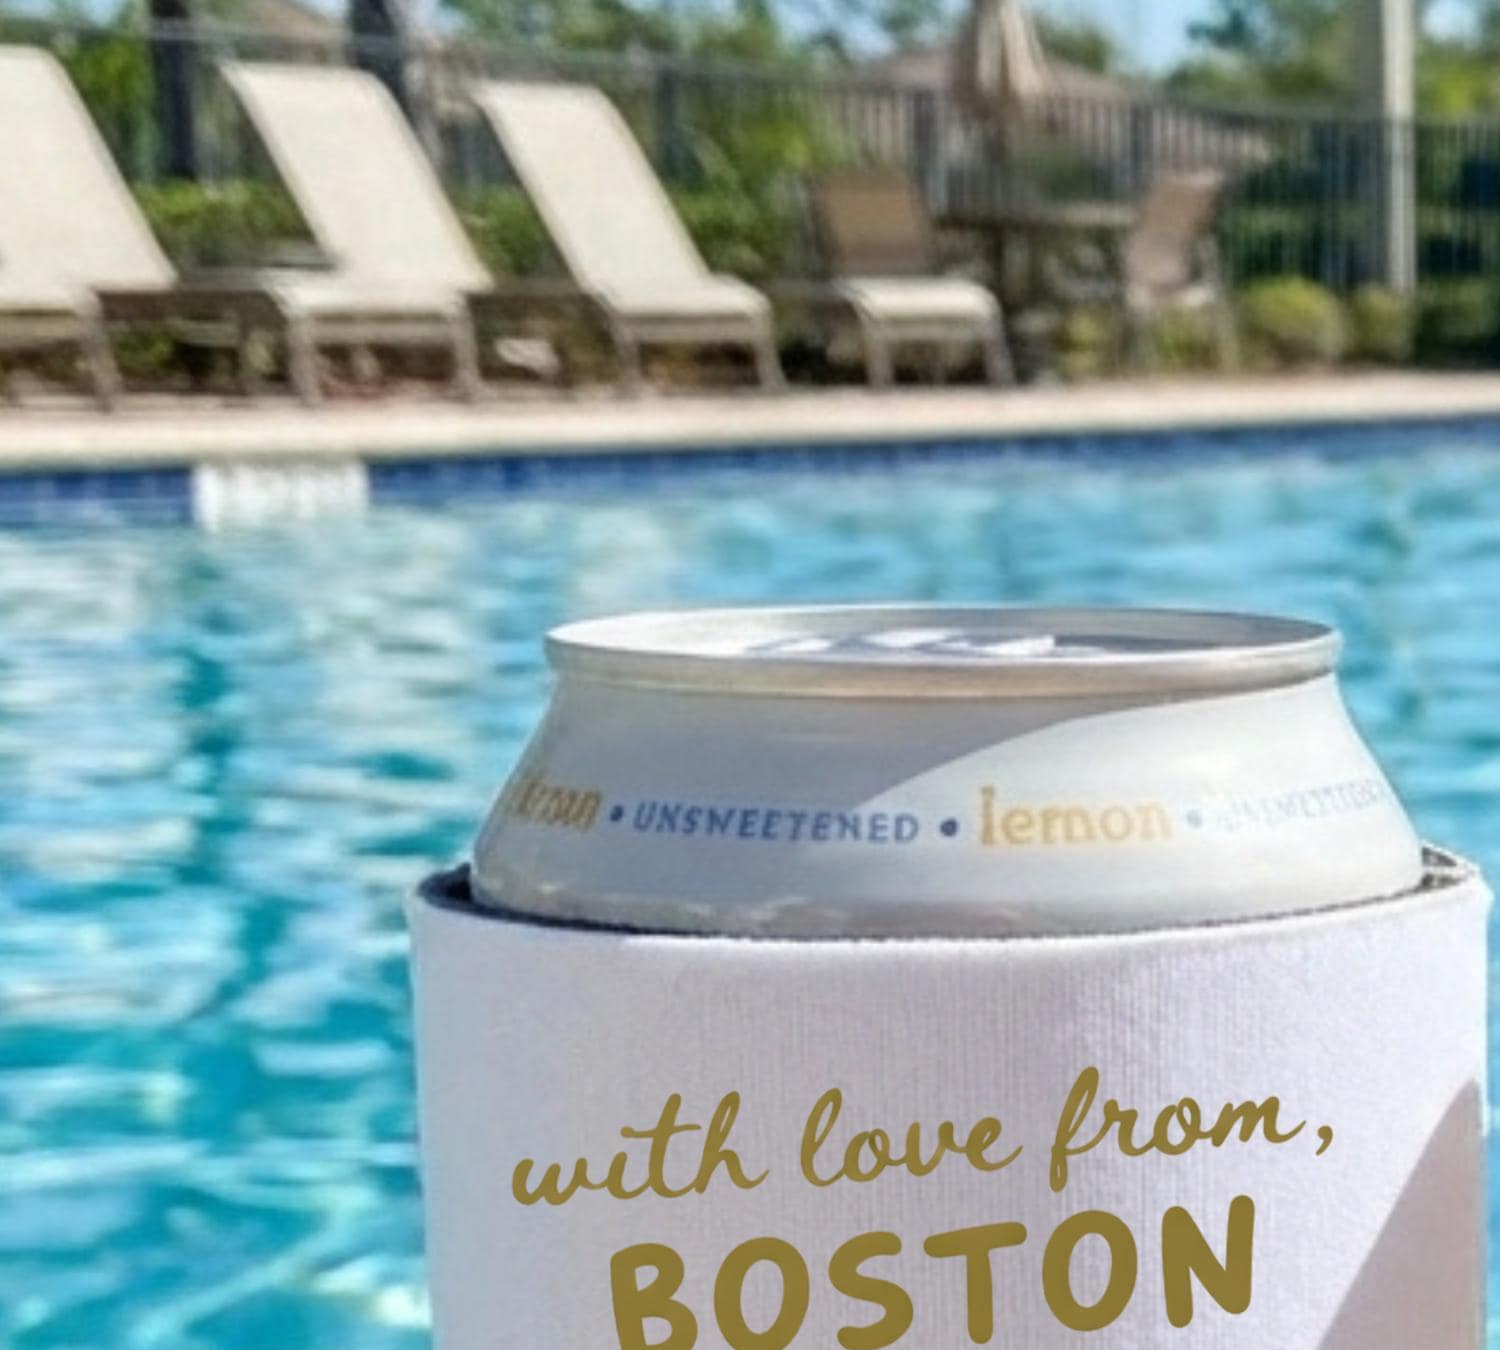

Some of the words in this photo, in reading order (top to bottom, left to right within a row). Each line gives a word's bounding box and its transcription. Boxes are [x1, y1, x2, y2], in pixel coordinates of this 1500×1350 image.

[979, 786, 1171, 845] lemon
[512, 1091, 768, 1205] with
[800, 1088, 1022, 1187] love
[1049, 1067, 1333, 1193] from,
